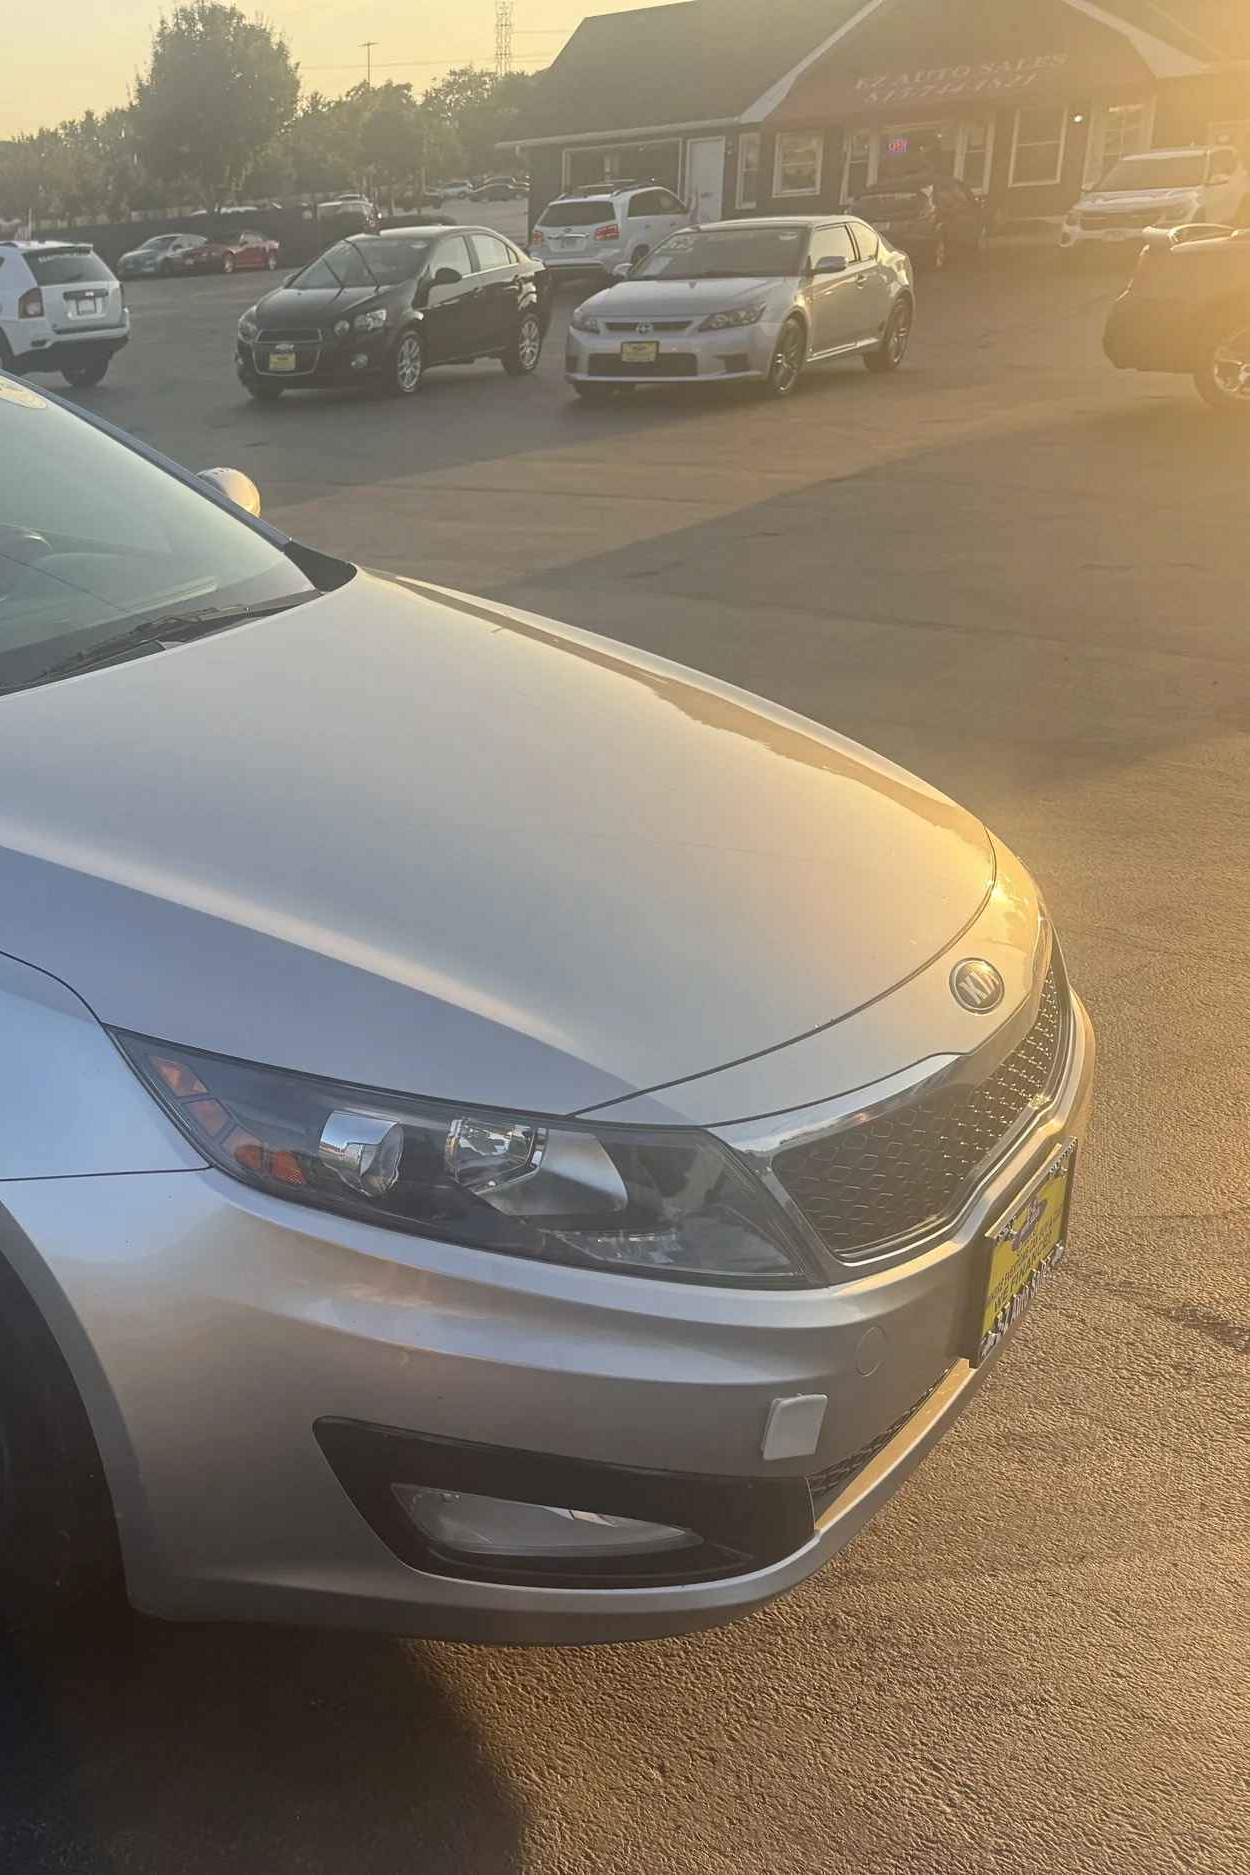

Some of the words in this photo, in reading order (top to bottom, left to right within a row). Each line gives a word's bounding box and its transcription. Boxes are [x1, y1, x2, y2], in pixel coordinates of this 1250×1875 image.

[855, 76, 887, 90] EZ
[892, 65, 971, 87] AUTO
[978, 53, 1067, 76] SALES
[958, 971, 1000, 1005] KIA
